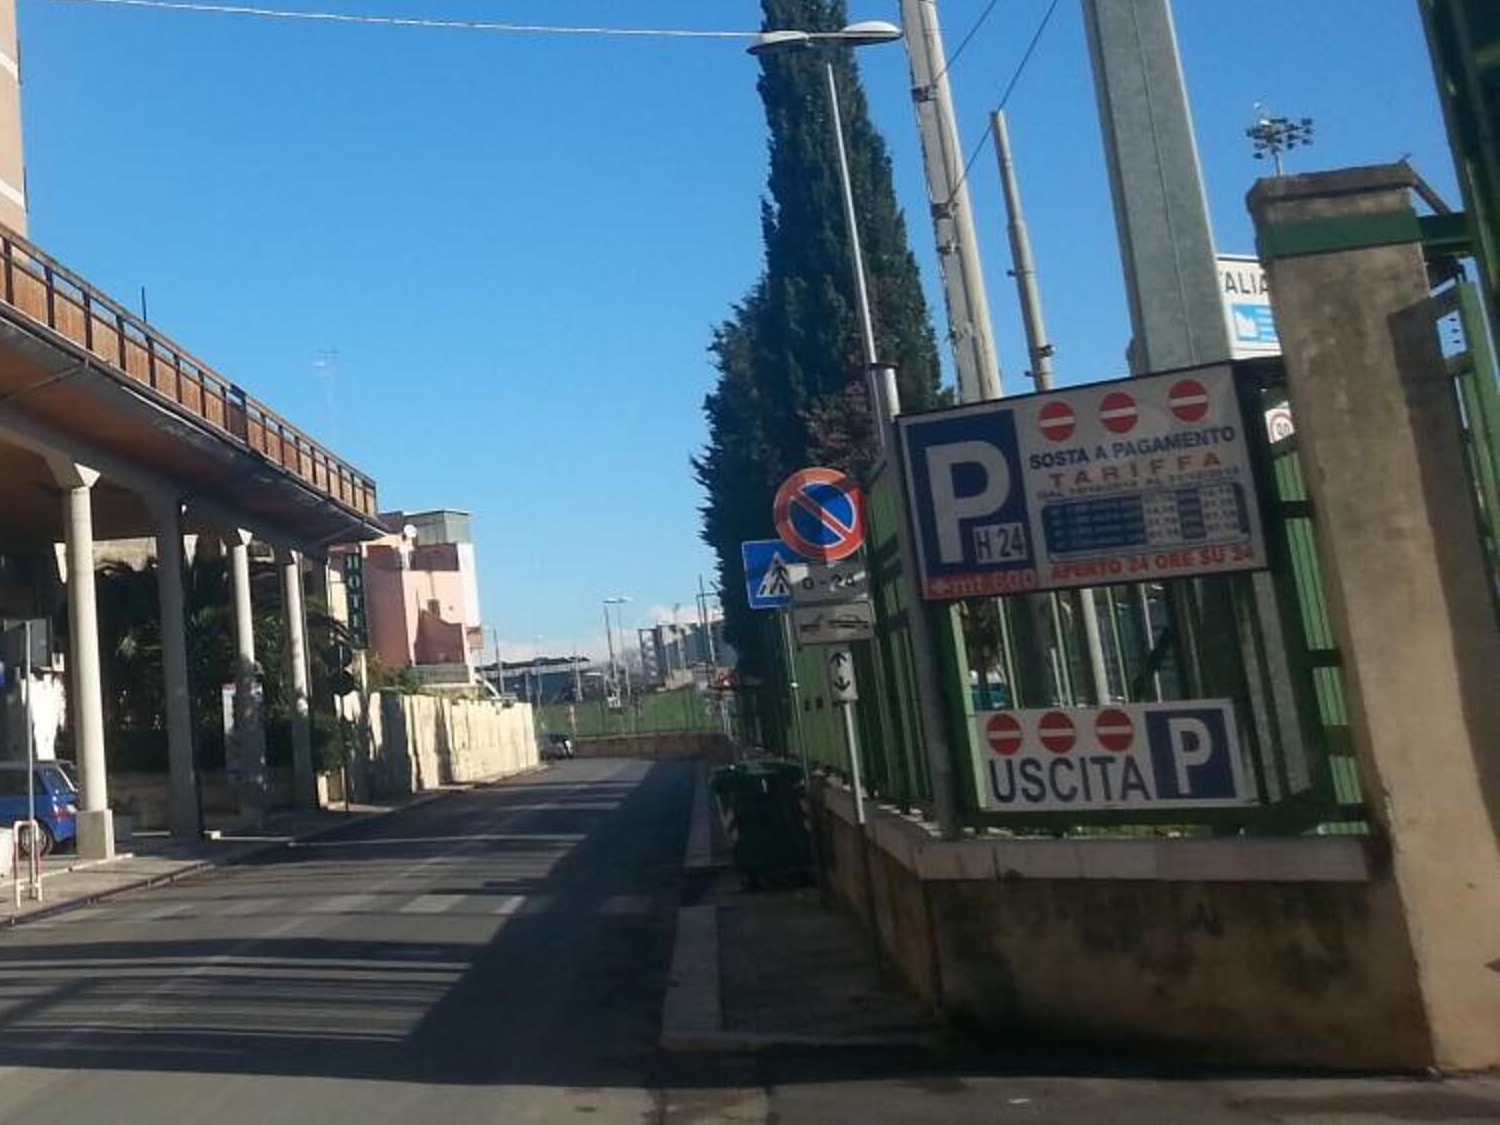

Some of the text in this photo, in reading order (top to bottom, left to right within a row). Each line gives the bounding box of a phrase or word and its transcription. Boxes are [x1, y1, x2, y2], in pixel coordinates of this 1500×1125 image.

[1029, 425, 1237, 470] SOSTA A PAGAMENTO
[925, 439, 1011, 564] P
[976, 525, 1027, 560] H 24
[989, 755, 1151, 804] USCITA
